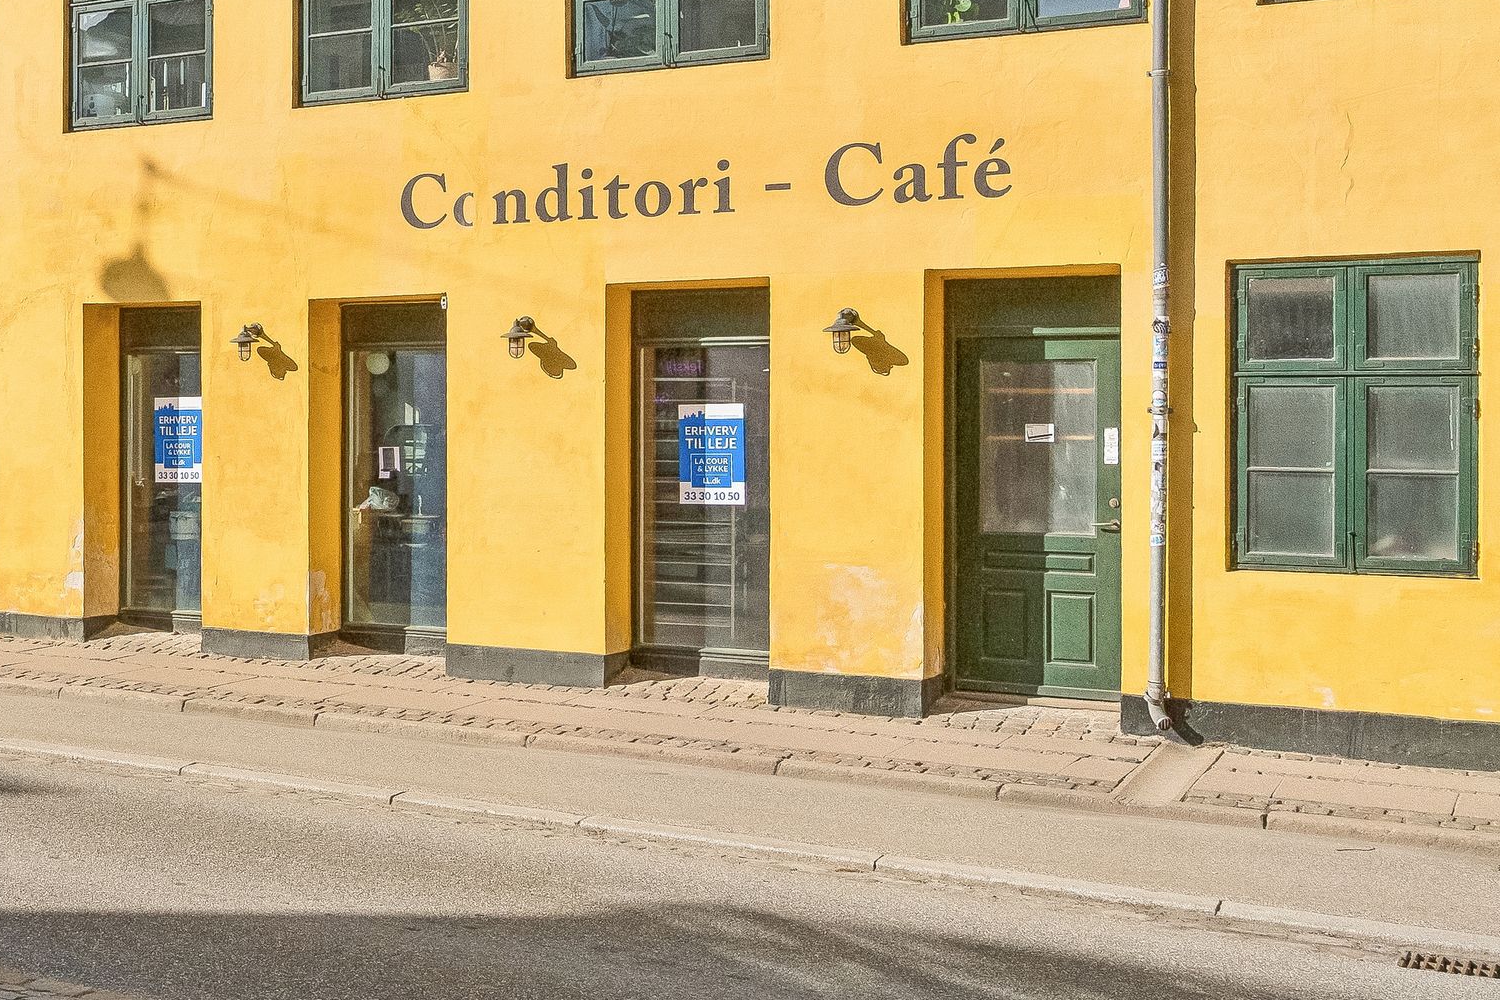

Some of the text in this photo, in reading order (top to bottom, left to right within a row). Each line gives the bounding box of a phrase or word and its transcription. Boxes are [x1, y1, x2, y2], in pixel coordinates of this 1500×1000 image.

[824, 133, 1013, 207] Café
[158, 415, 198, 425] ERHVERV
[159, 426, 198, 436] TIL LEJE
[684, 425, 738, 436] ERHVERV
[684, 437, 737, 449] TIL LEJE
[694, 457, 728, 465] LA COUR
[705, 465, 728, 473] LYKKE
[158, 471, 199, 480] 33 30 10 50
[684, 491, 740, 501] 33 30 10 50
